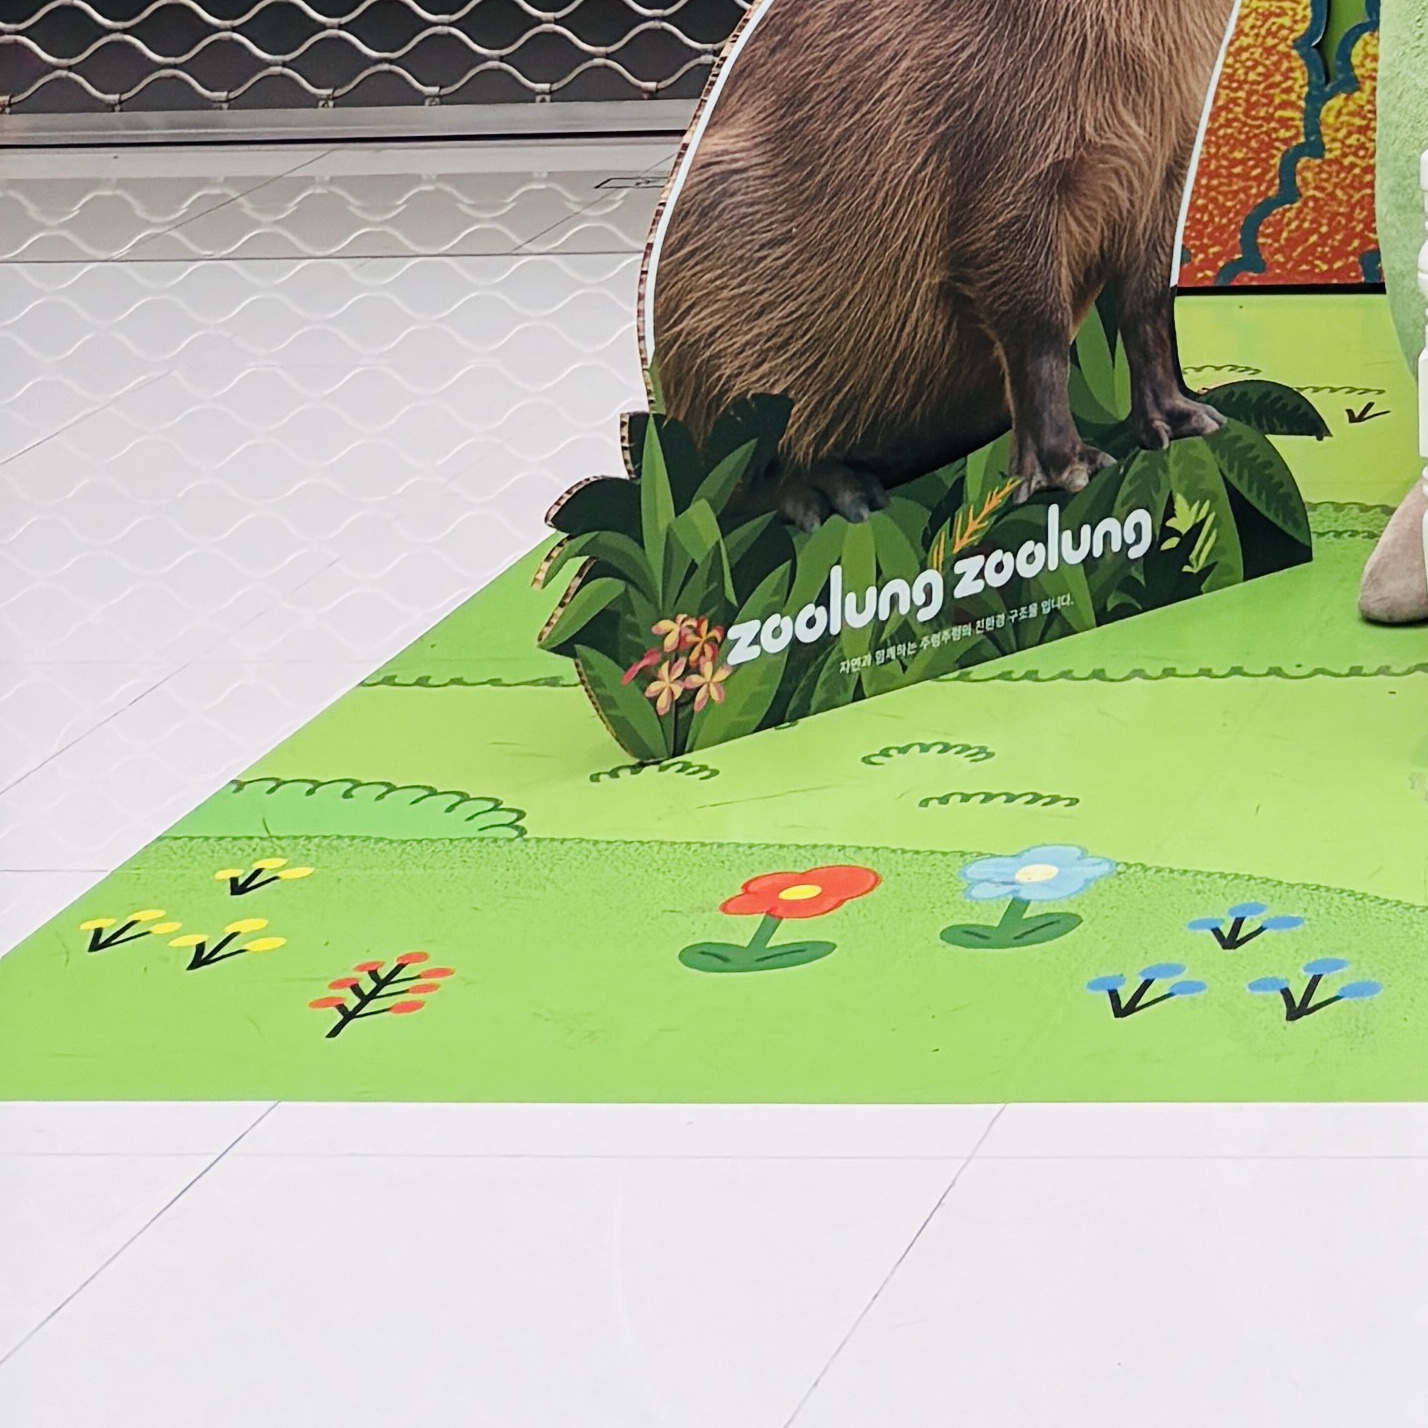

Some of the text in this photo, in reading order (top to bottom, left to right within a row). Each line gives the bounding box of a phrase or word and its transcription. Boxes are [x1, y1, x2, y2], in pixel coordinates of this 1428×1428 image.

[726, 504, 1152, 665] zoolung zoolung
[920, 624, 972, 650] 주렁주렁의
[976, 612, 1006, 635] 친환경
[1041, 592, 1074, 615] 입니다.
